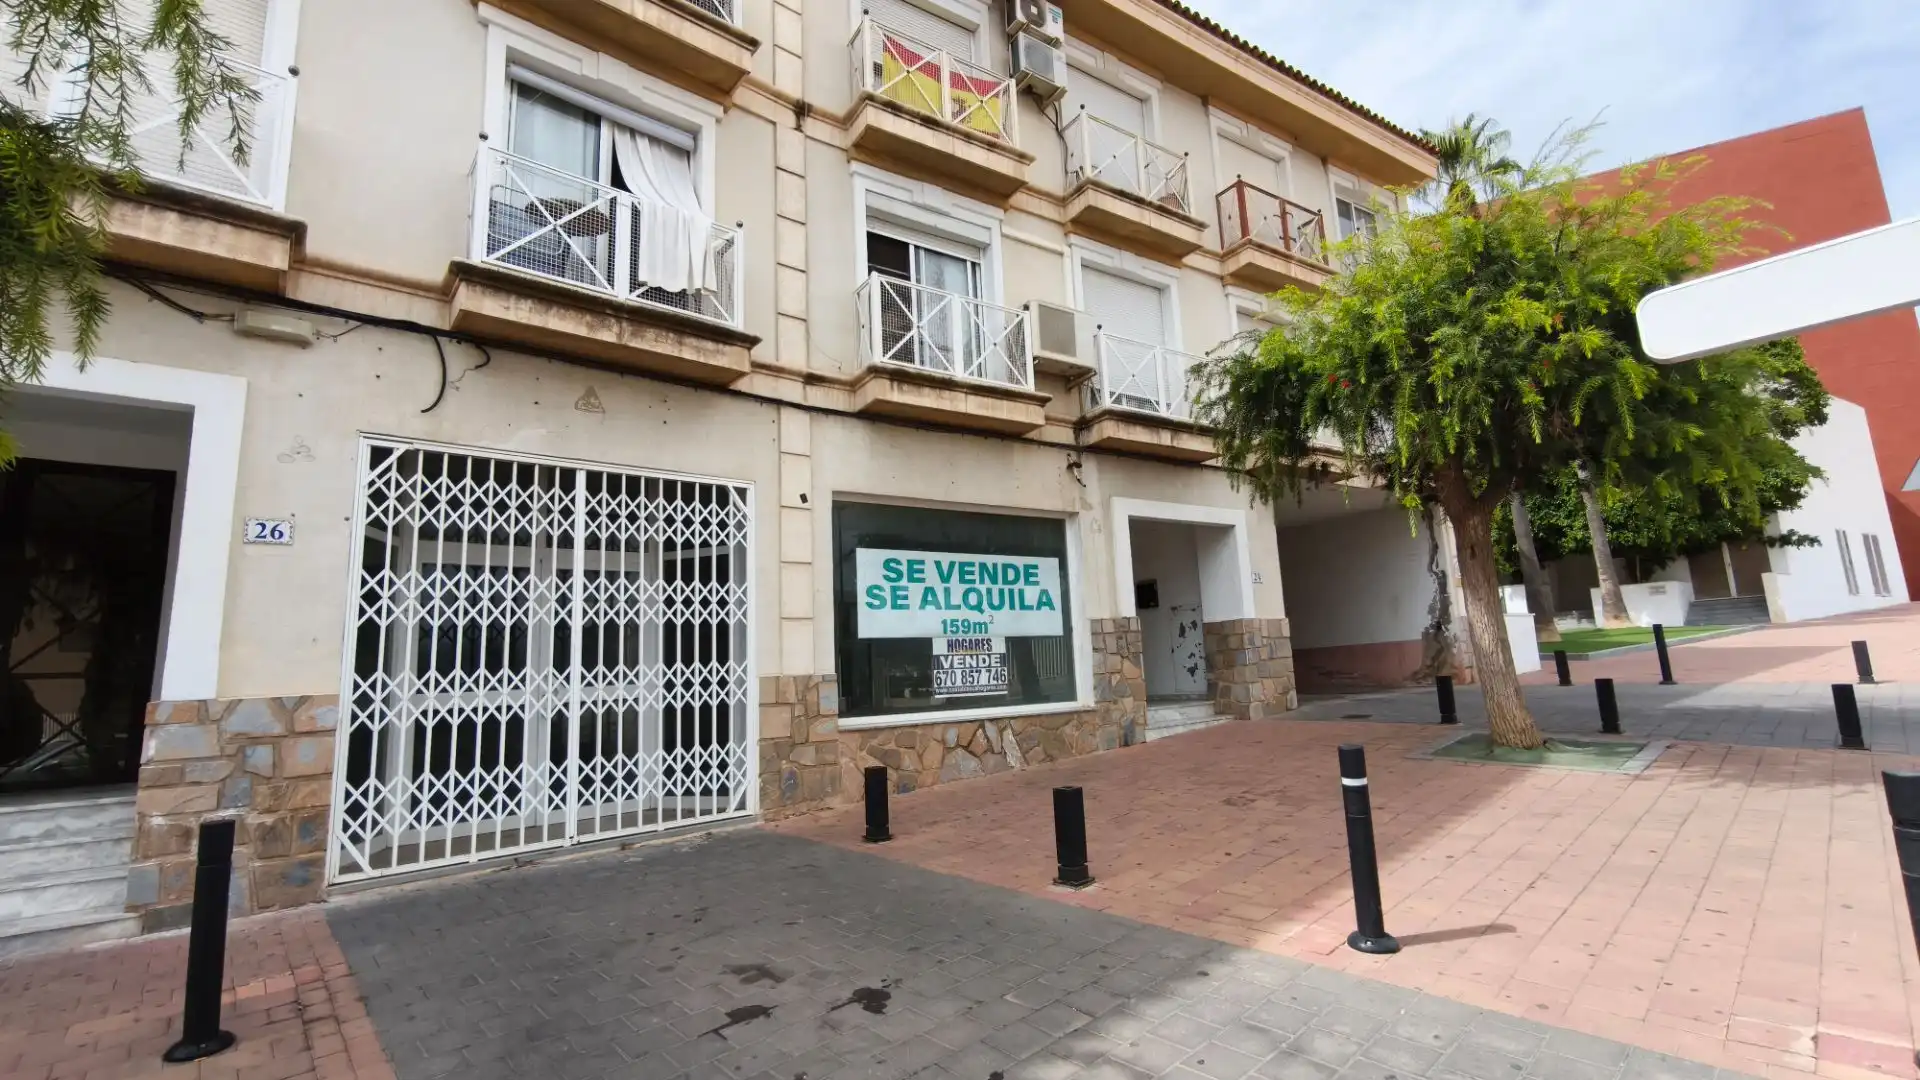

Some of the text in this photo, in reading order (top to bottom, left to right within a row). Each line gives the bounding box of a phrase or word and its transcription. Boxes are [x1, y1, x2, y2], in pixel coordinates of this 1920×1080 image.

[254, 522, 284, 540] 26
[882, 557, 1040, 586] SE VENDE
[865, 584, 1056, 614] SE ALQUILA
[947, 638, 993, 653] HOGARES
[940, 654, 1001, 668] VENDE
[934, 668, 1007, 686] 670 857 746
